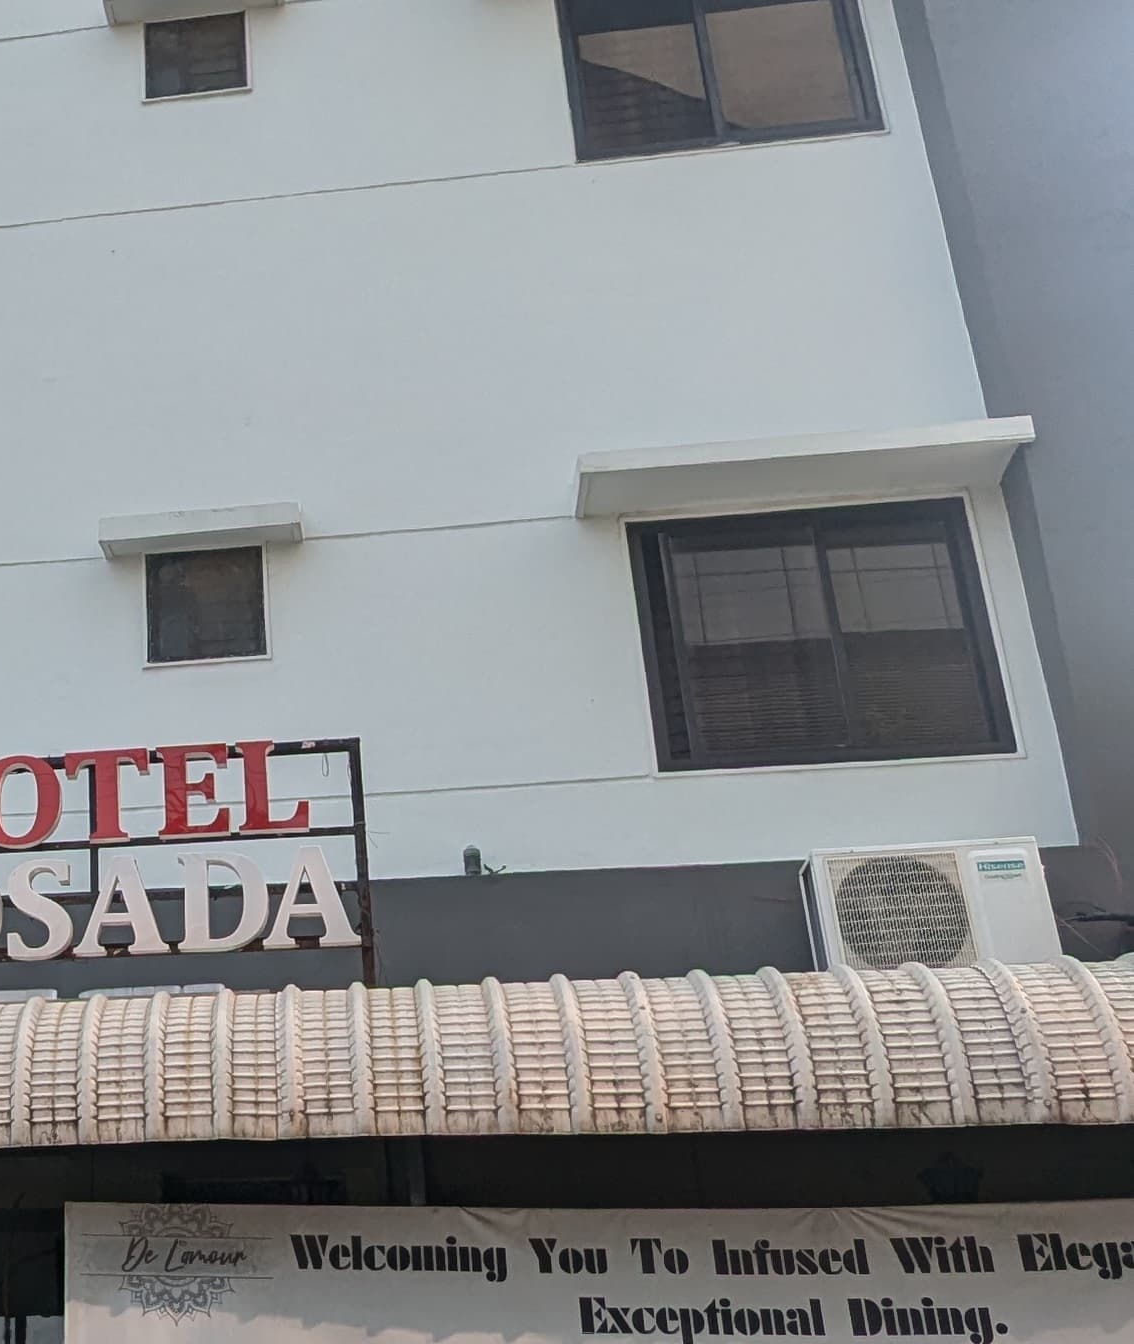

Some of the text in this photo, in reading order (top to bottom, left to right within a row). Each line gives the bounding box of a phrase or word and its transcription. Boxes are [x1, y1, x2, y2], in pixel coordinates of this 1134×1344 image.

[122, 1236, 159, 1272] De
[291, 1234, 508, 1282] Welcoming
[529, 1237, 608, 1275] You
[630, 1237, 690, 1275] To
[712, 1238, 871, 1276] Infused
[890, 1234, 995, 1274] With
[578, 1296, 1009, 1344] Exceptional Dining.
